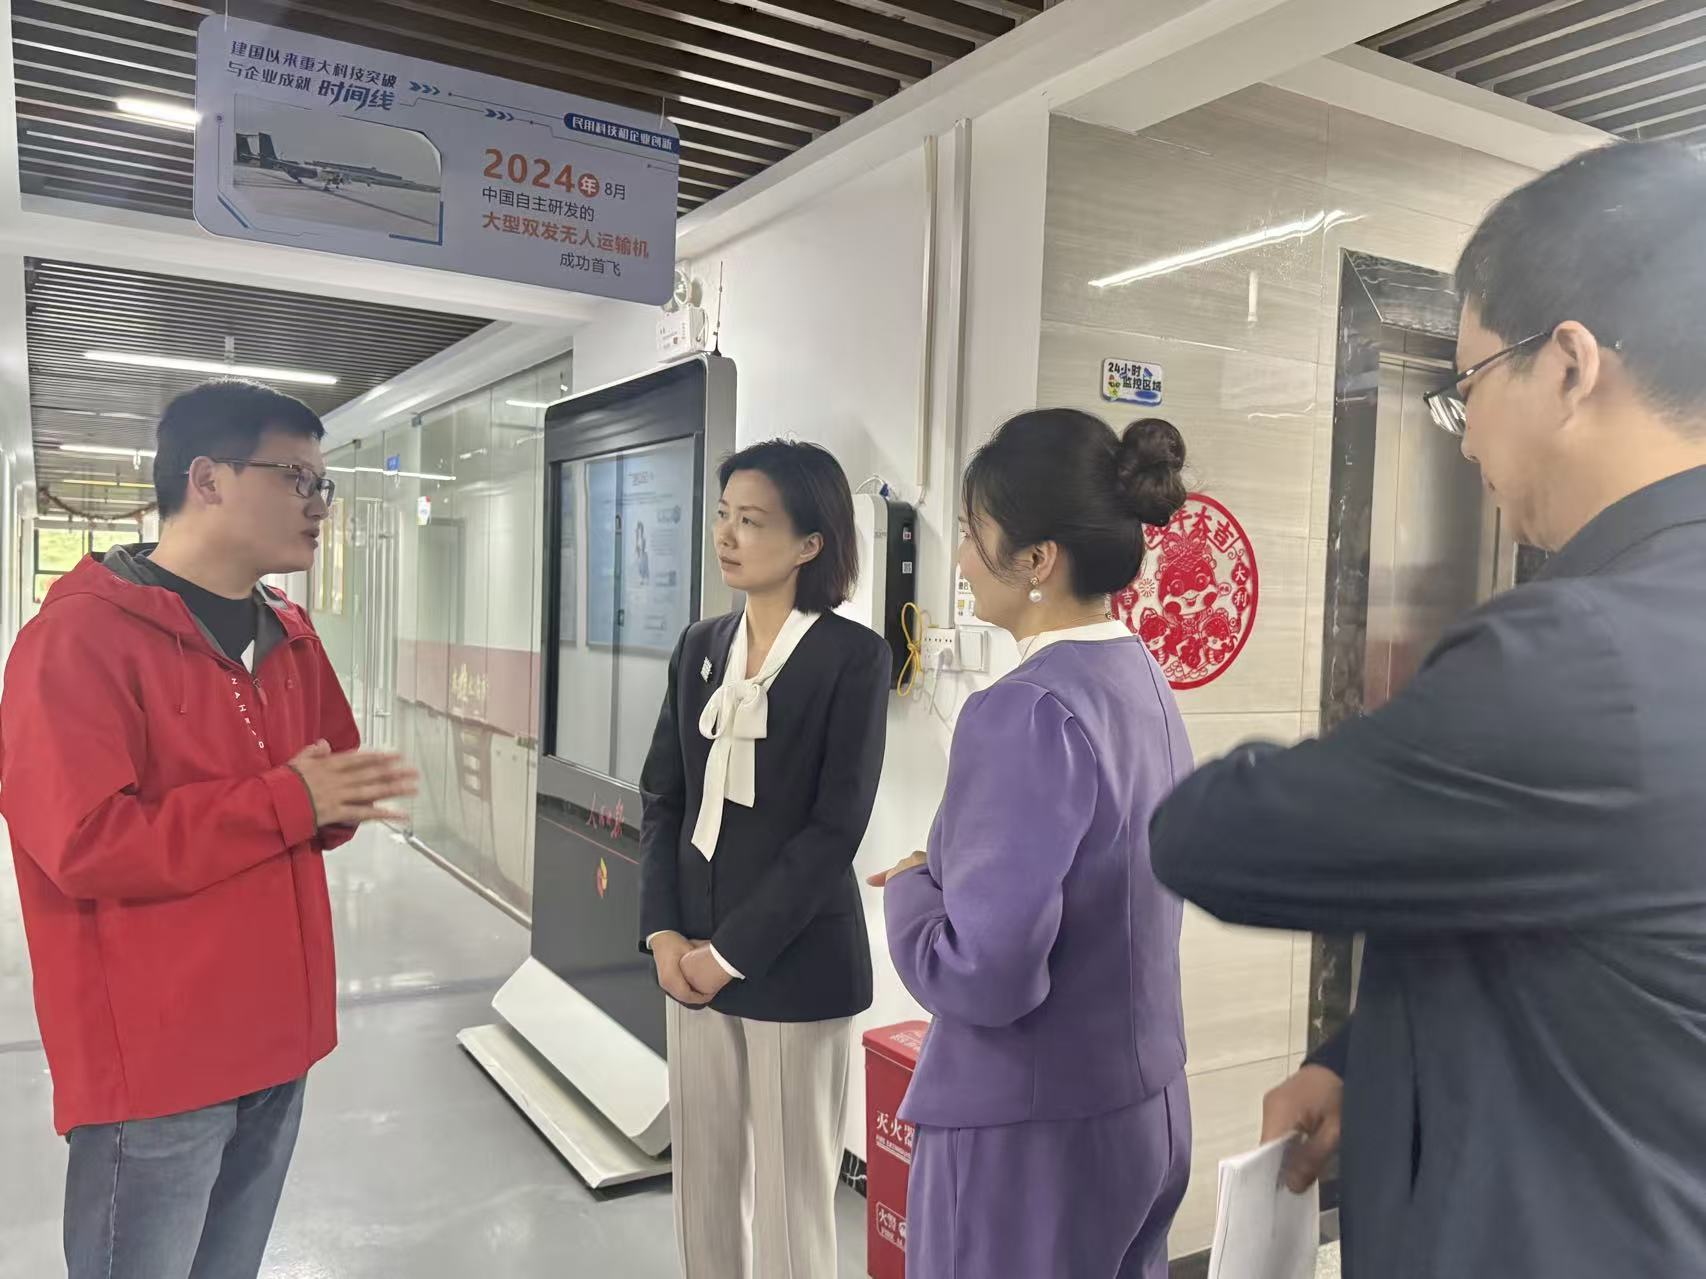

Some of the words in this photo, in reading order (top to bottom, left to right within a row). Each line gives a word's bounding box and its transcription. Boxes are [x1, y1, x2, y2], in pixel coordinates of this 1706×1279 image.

[231, 40, 397, 88] 建国以来重大科技突破
[227, 60, 311, 92] 与企业成就
[318, 79, 395, 111] 时间线
[572, 116, 672, 150] 民用科技和企业创新
[483, 148, 600, 198] 2024年
[604, 182, 626, 200] 8月
[482, 186, 595, 222] 中国自主研发的
[482, 211, 649, 259] 大型双发无人运输机
[560, 252, 622, 277] 成功首飞
[1108, 362, 1141, 378] 24小时
[1122, 376, 1162, 392] 监控区域
